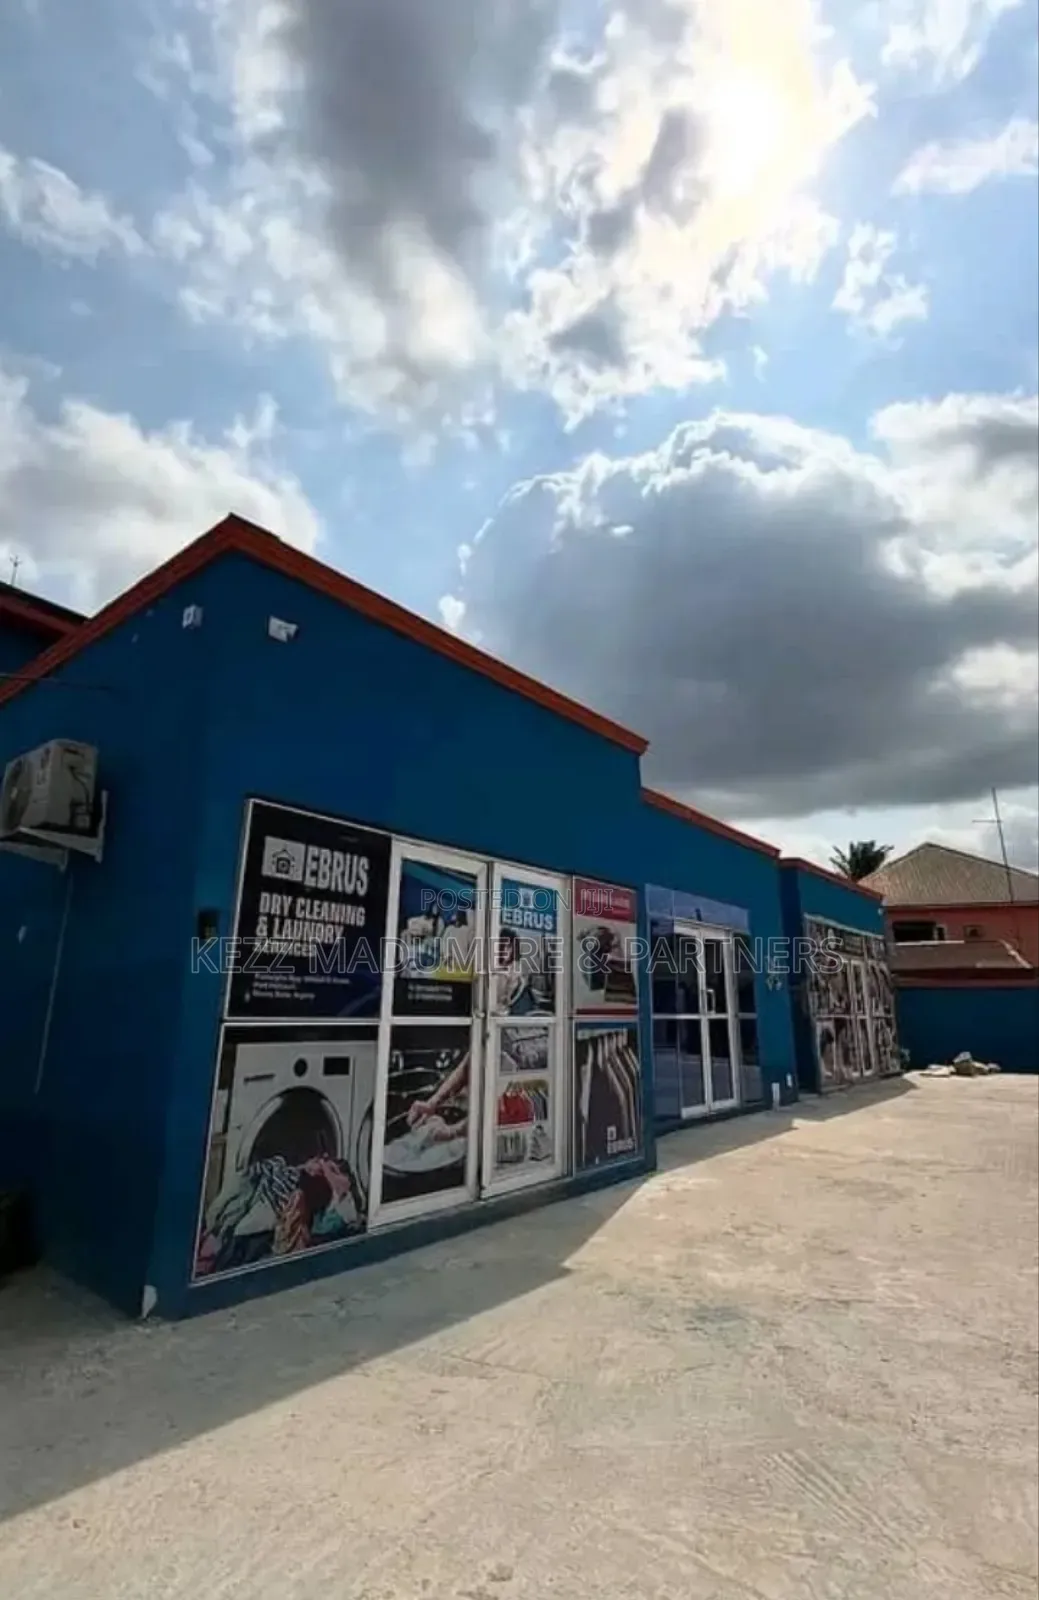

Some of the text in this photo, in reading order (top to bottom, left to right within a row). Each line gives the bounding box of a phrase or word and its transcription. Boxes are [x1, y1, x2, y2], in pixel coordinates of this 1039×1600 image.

[304, 845, 369, 896] EBRUS
[260, 892, 366, 927] DRY CLEANING
[502, 907, 555, 930] EBRUS
[256, 915, 344, 944] & LAUNDRY
